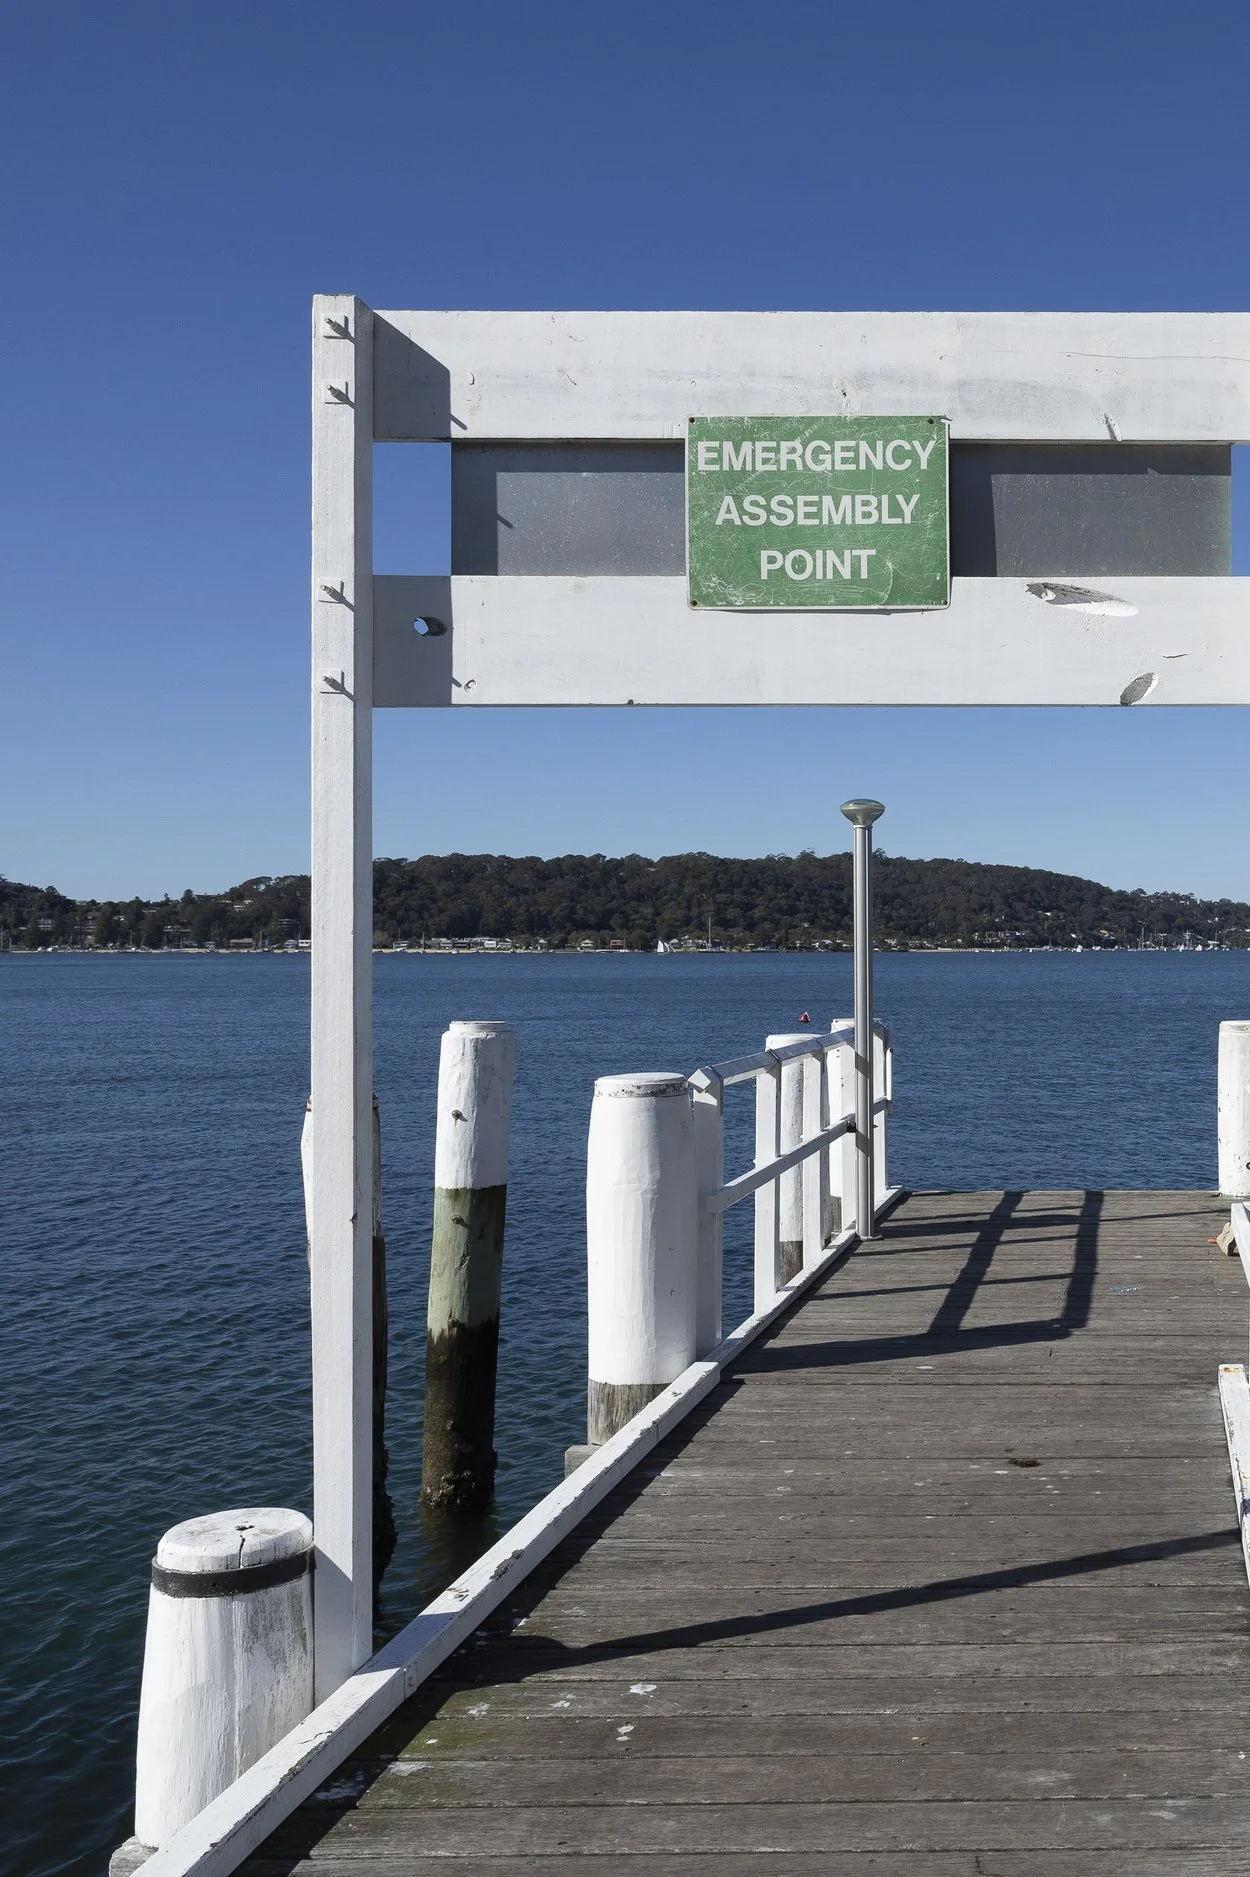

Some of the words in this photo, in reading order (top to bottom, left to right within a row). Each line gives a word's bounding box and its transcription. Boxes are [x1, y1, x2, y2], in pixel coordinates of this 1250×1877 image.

[697, 440, 936, 471] EMERGENCY
[714, 494, 921, 526] ASSEMBLY
[760, 549, 876, 581] POINT
